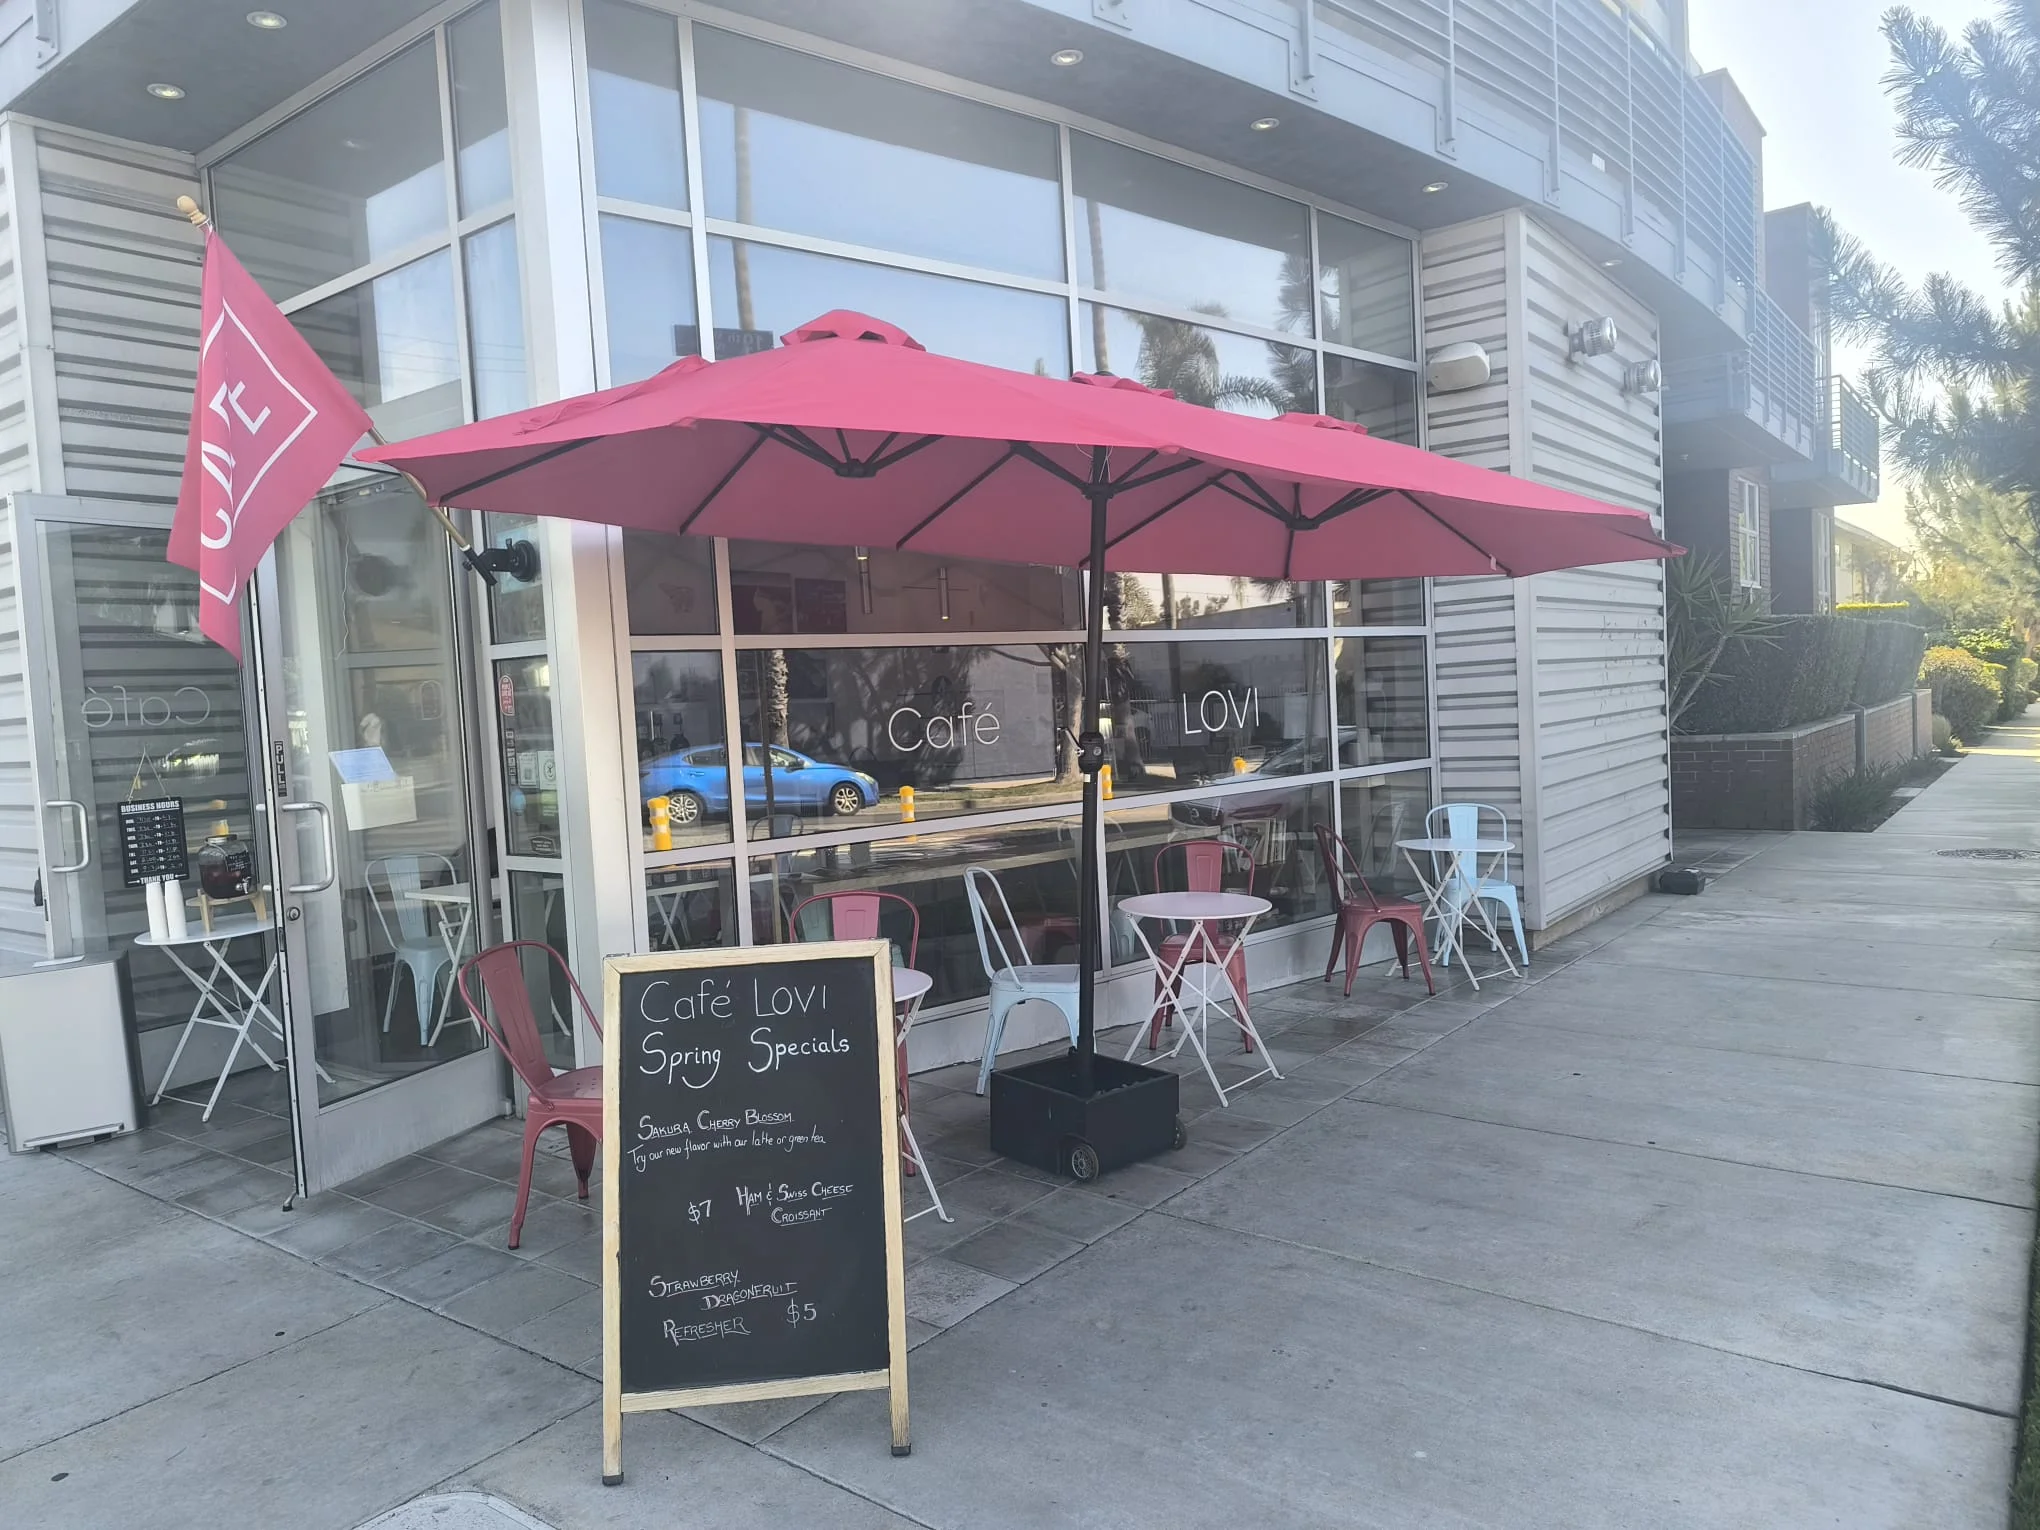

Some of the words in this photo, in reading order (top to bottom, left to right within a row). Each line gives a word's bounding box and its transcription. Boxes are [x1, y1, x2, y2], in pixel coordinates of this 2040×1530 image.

[888, 701, 1000, 752] Café
[1183, 687, 1261, 735] LOVI
[275, 744, 286, 784] PULL
[121, 802, 155, 813] BUSINESS
[156, 800, 180, 809] HOURS
[163, 873, 175, 881] YOU
[640, 979, 732, 1023] Café
[754, 977, 827, 1018] LOVI
[640, 1031, 721, 1089] Spring
[748, 1026, 850, 1073] Specials
[637, 1114, 692, 1140] SAKURA
[696, 1109, 740, 1132] CHERRY
[745, 1108, 794, 1125] BLOSSOM
[627, 1143, 646, 1173] Try
[648, 1150, 664, 1161] our
[665, 1147, 682, 1156] new
[683, 1138, 711, 1160] flavor
[713, 1134, 732, 1149] with
[734, 1138, 748, 1148] our
[751, 1129, 774, 1146] latte
[776, 1135, 787, 1145] or
[788, 1135, 809, 1153] green
[810, 1123, 827, 1144] tea
[688, 1199, 712, 1225] $7
[735, 1184, 762, 1216] HAM
[776, 1183, 808, 1203] SWISS
[770, 1206, 833, 1227] CROISSANT
[648, 1268, 741, 1298] STRAWBERRY
[700, 1282, 798, 1311] DRAGONFRUIT
[786, 1298, 817, 1328] $5
[663, 1316, 752, 1347] REFRESHER
